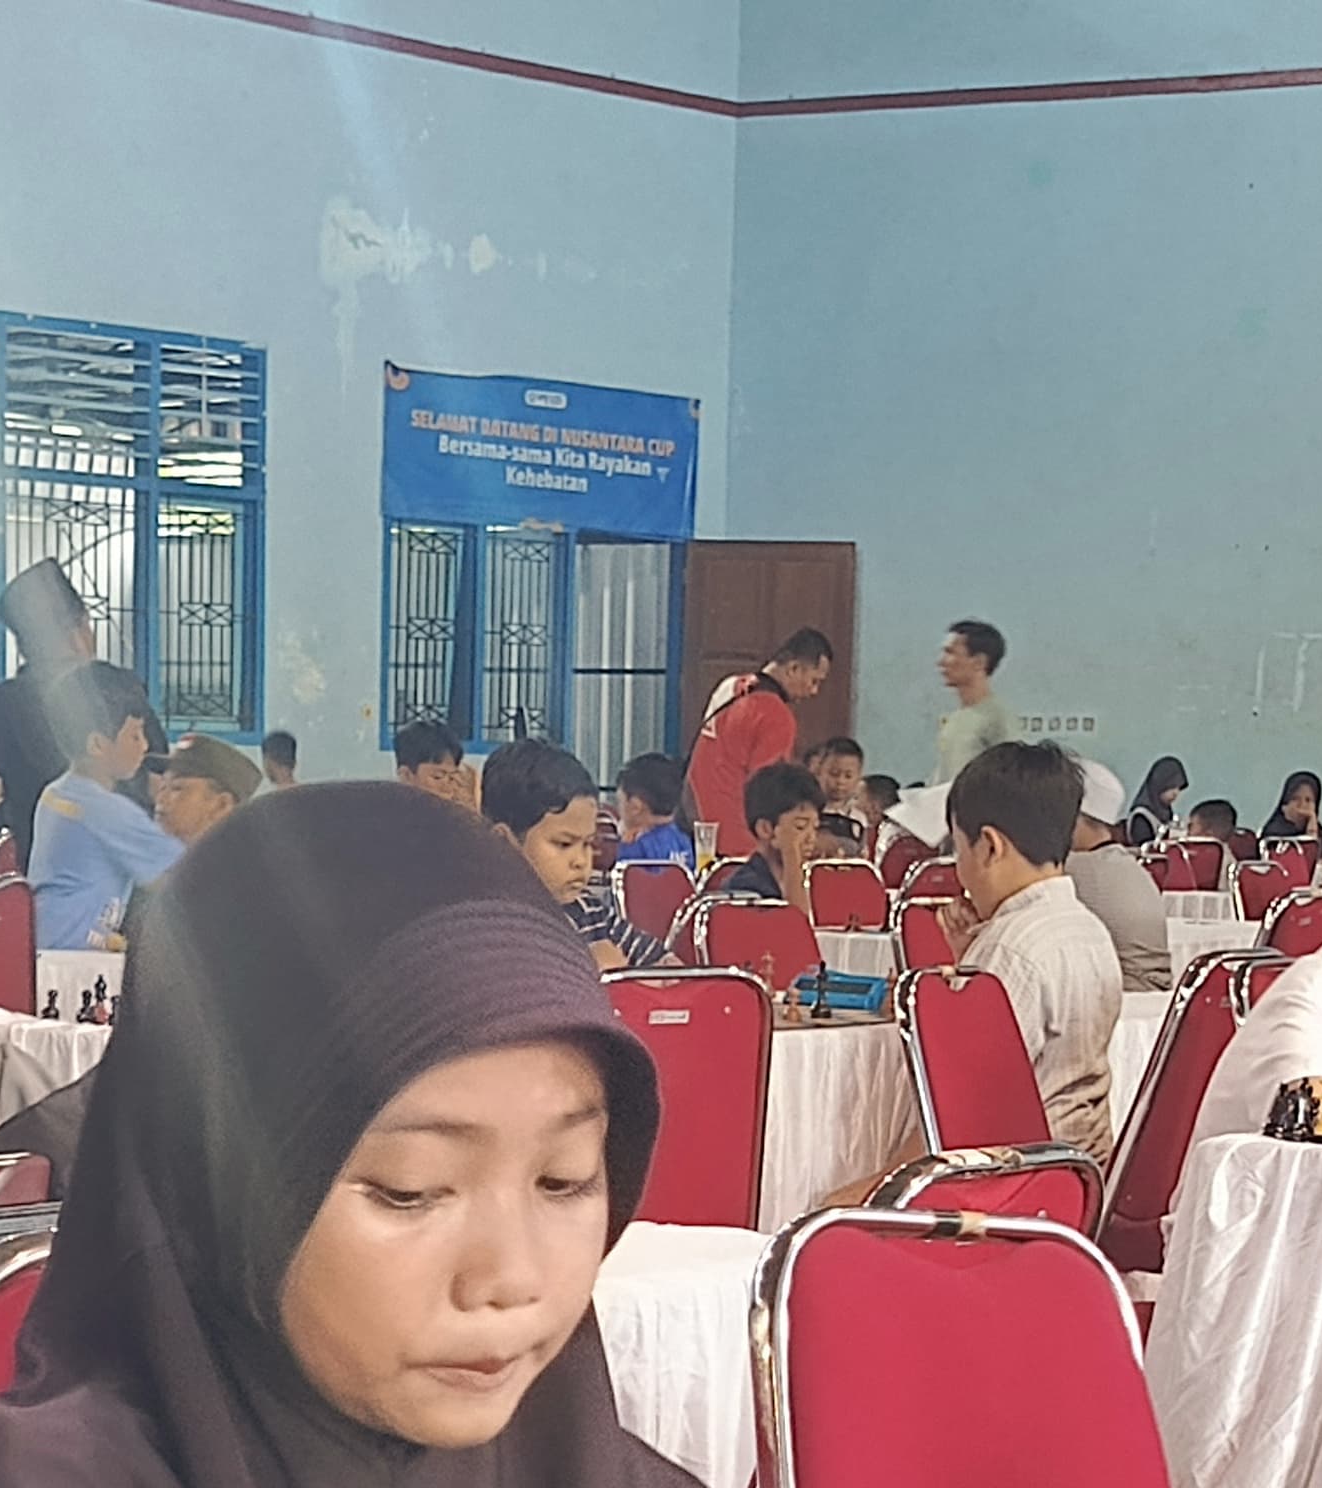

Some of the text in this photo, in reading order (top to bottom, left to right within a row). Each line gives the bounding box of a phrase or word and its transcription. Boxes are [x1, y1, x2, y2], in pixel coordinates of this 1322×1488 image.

[410, 409, 675, 457] SELAMAT DATANG DI NUSANTARA CUP
[438, 433, 652, 478] Bersama-sama Kita Rayakan
[505, 465, 588, 493] Kehebatan
